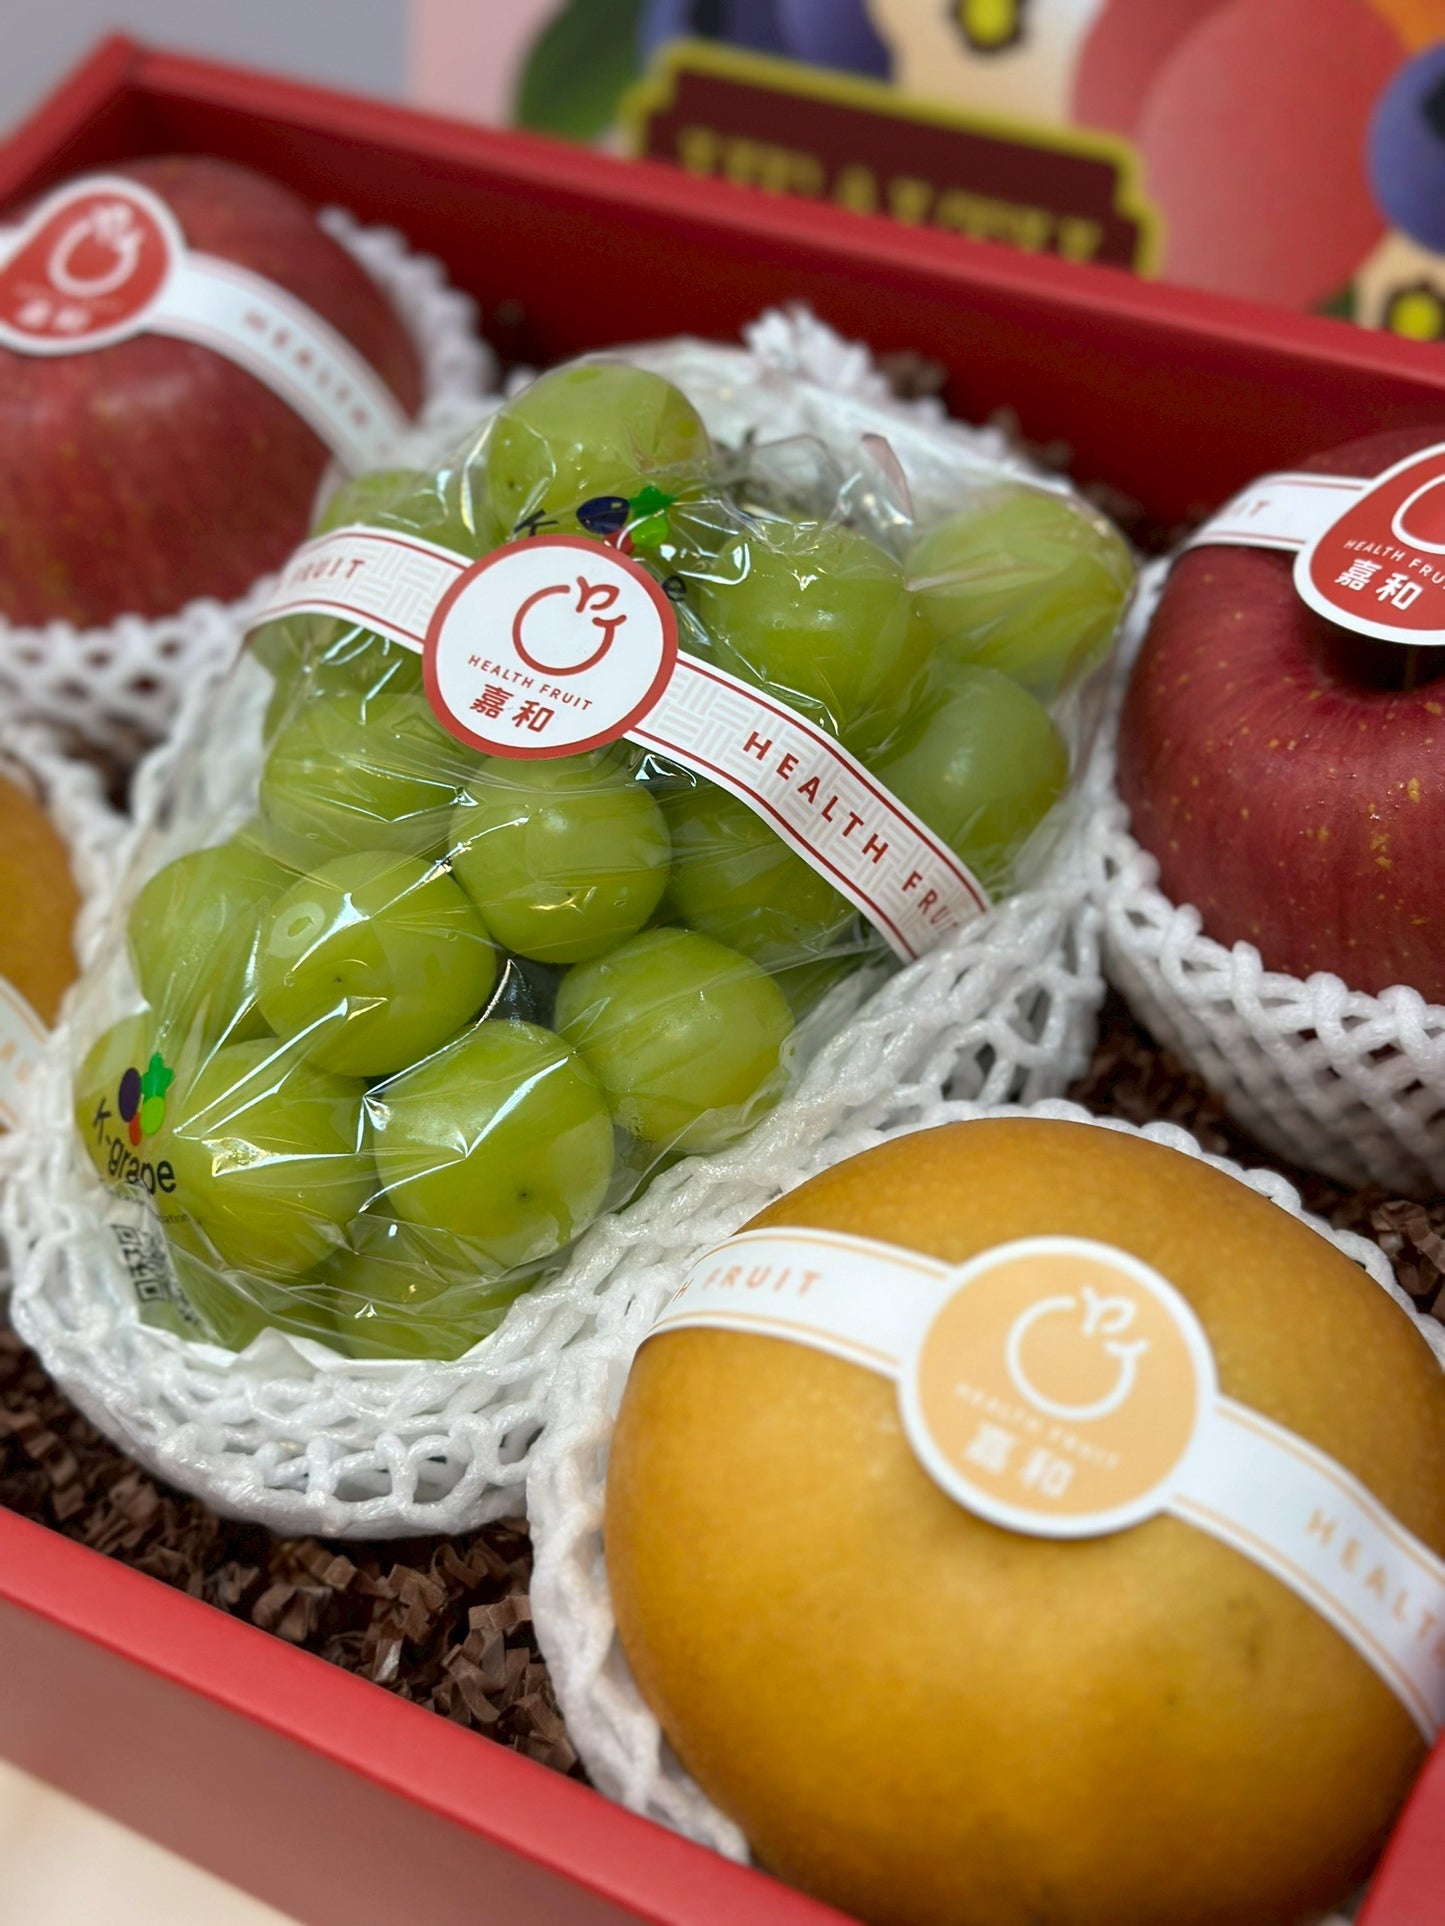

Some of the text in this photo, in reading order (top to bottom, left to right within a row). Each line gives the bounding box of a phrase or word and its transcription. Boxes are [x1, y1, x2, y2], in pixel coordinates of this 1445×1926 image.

[1334, 558, 1423, 611] 嘉和
[1343, 539, 1445, 590] HEALTH FRU
[468, 655, 593, 711] HEALTH FRUIT
[469, 683, 555, 733] 嘉和
[743, 731, 889, 864] HEALTH
[93, 1098, 177, 1195] K-grape
